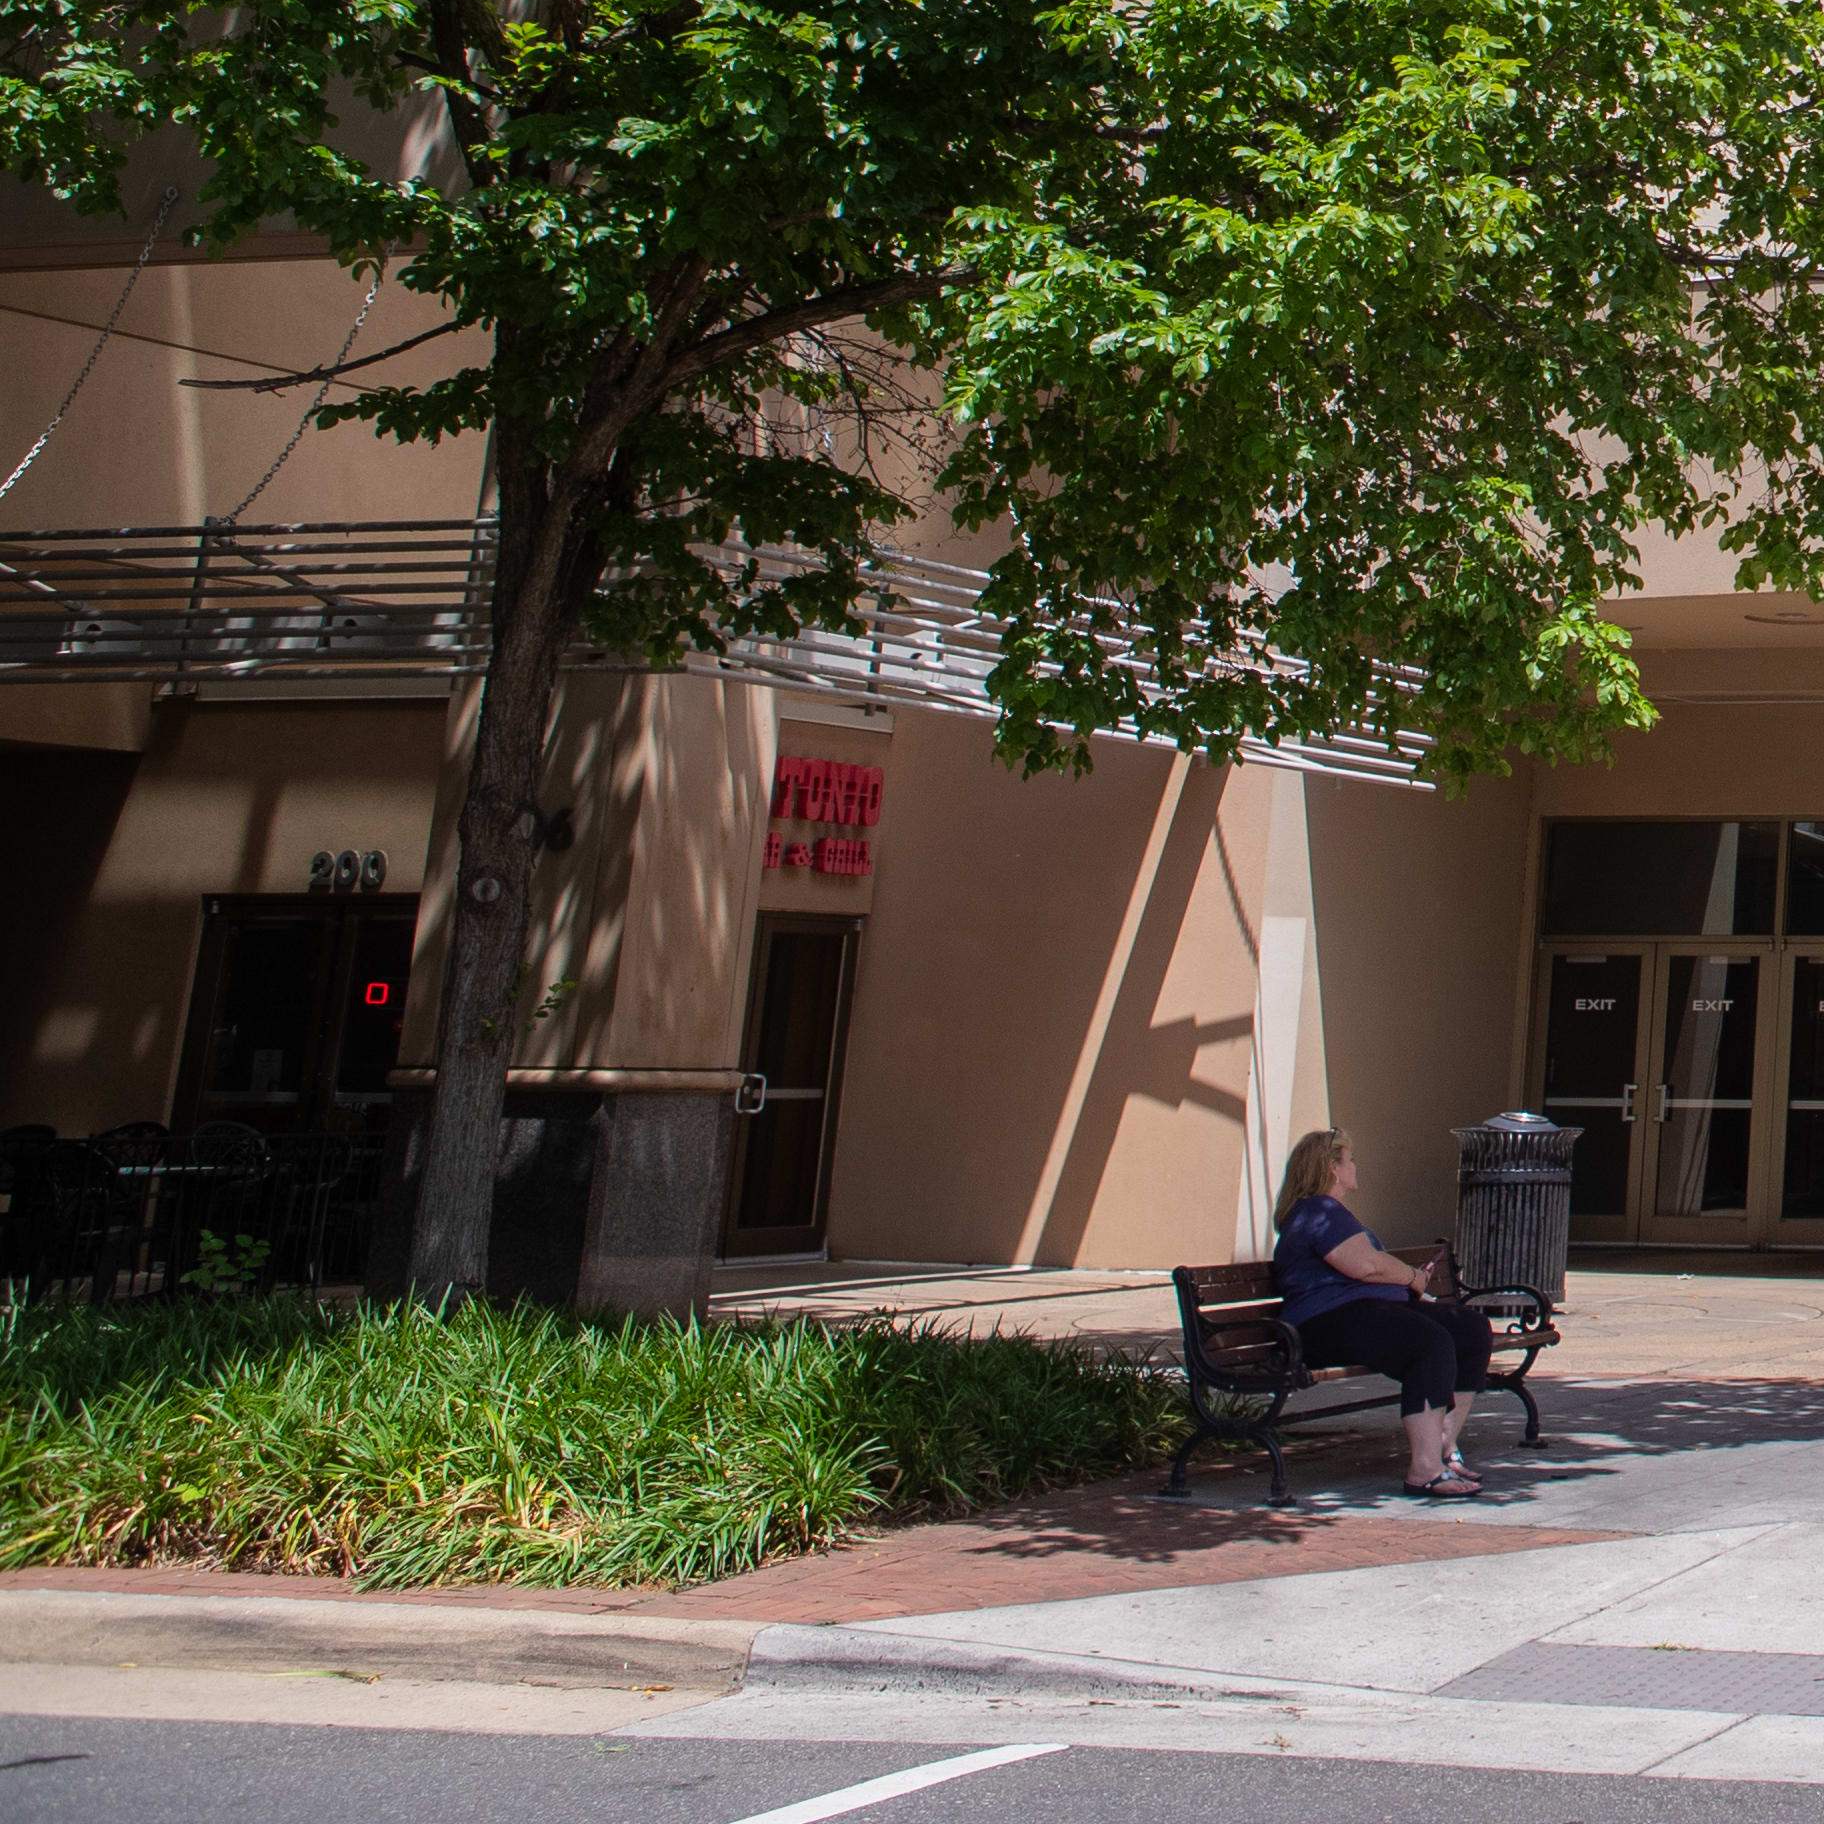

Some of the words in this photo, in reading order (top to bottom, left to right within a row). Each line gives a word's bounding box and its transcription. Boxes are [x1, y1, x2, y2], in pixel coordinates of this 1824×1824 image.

[785, 841, 812, 867] &
[820, 836, 872, 875] GRILL
[309, 849, 389, 892] 200
[1575, 998, 1617, 1011] EXIT
[1692, 999, 1734, 1012] EXIT
